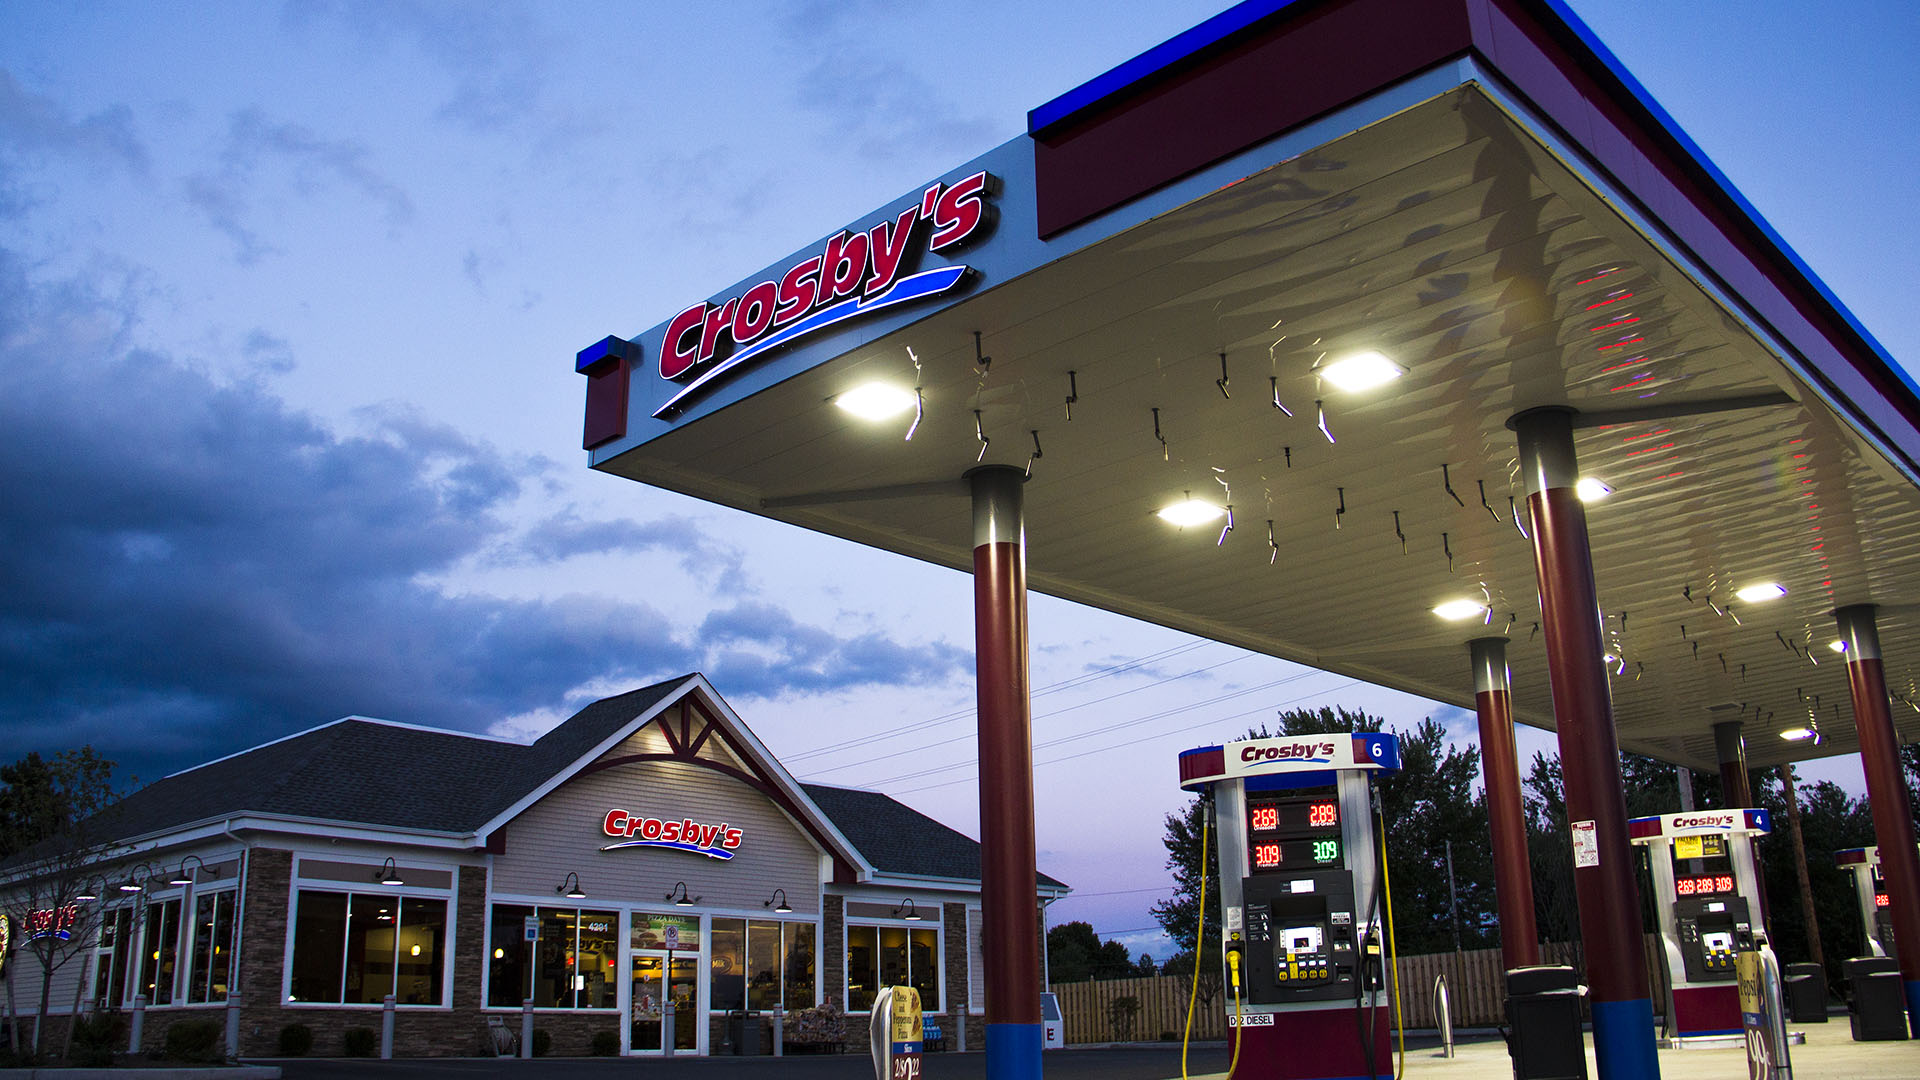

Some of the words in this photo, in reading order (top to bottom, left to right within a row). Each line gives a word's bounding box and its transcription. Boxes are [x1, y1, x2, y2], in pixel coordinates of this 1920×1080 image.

[658, 170, 986, 381] Crosby's
[1241, 742, 1335, 762] Crosby's
[1372, 743, 1382, 757] 6
[1253, 808, 1277, 827] 2.69
[1310, 804, 1335, 824] 2.89
[1672, 815, 1734, 828] Crosby's
[1755, 815, 1763, 825] 4
[604, 809, 743, 849] Crosby's
[1256, 845, 1280, 864] 3.09
[1313, 841, 1338, 860] 3.09
[1246, 1015, 1273, 1025] DIESEL
